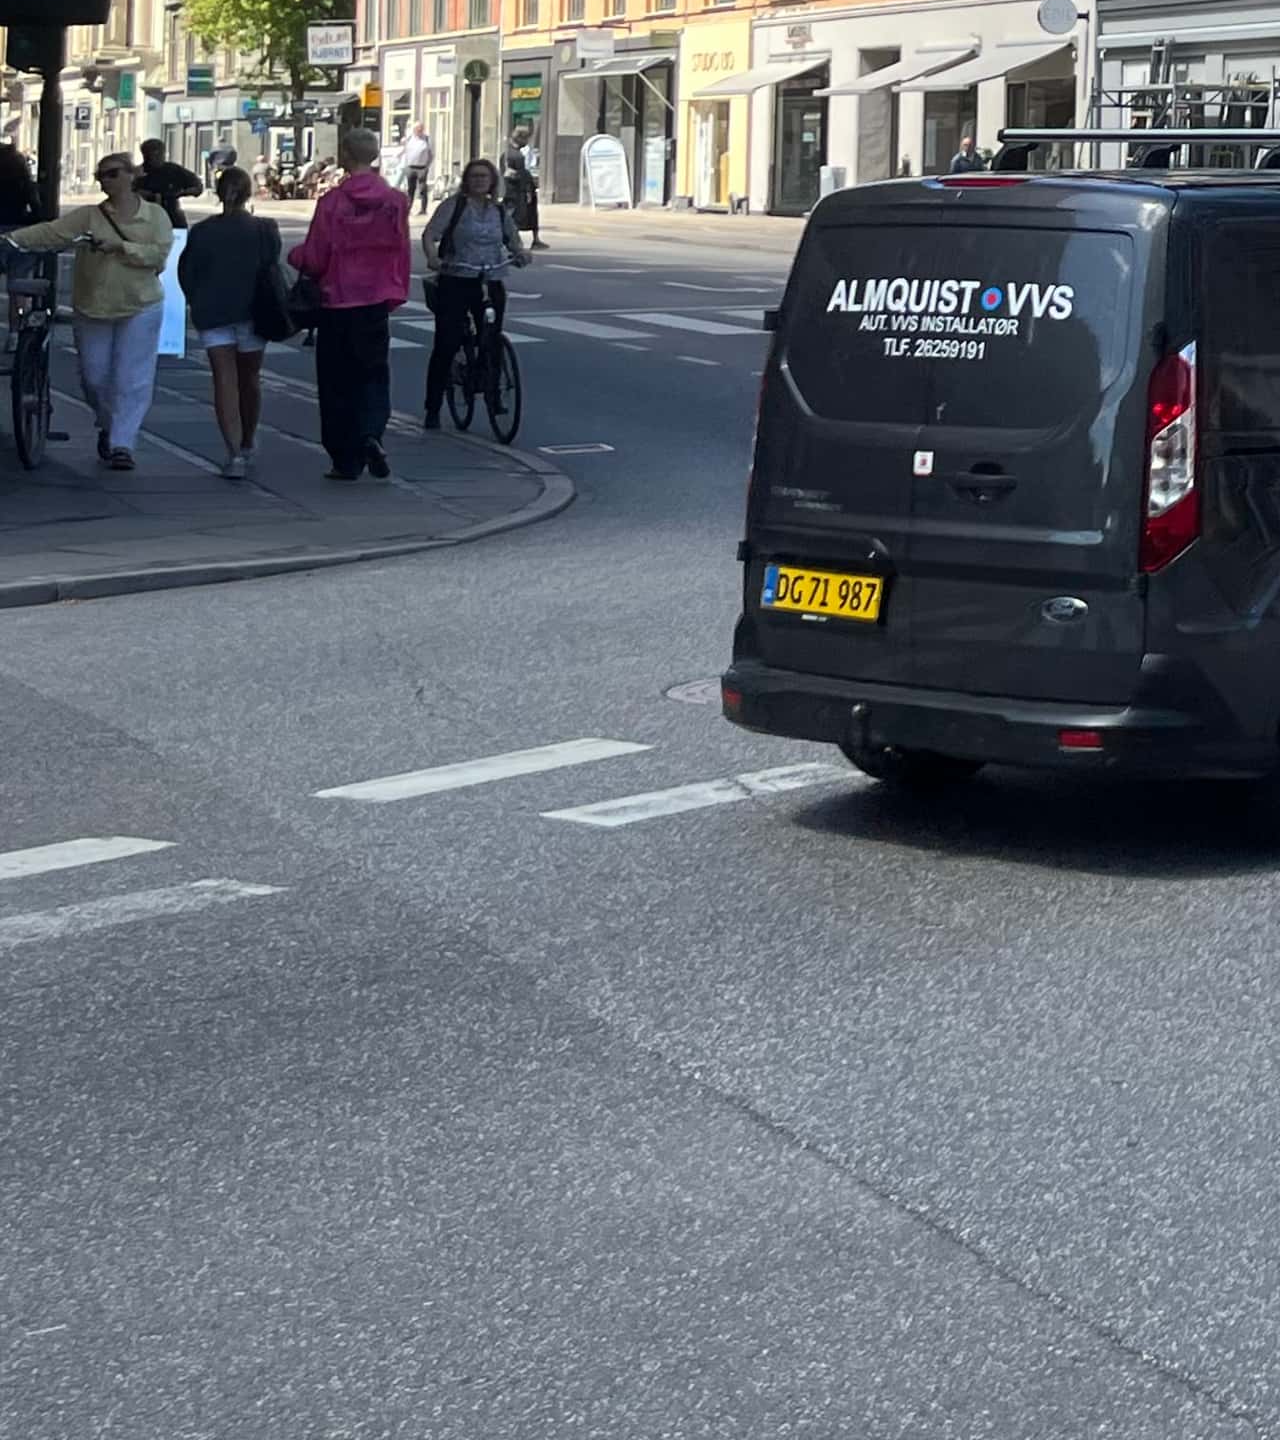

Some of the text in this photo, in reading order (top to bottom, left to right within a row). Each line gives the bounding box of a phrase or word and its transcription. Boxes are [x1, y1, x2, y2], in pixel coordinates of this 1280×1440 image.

[79, 107, 88, 120] P
[826, 277, 1075, 320] ALMQUIST VVS
[858, 314, 1019, 336] AUT. VVS INSTALLATØR
[883, 337, 987, 360] TLF. 26259191
[776, 573, 878, 612] DG 71 987
